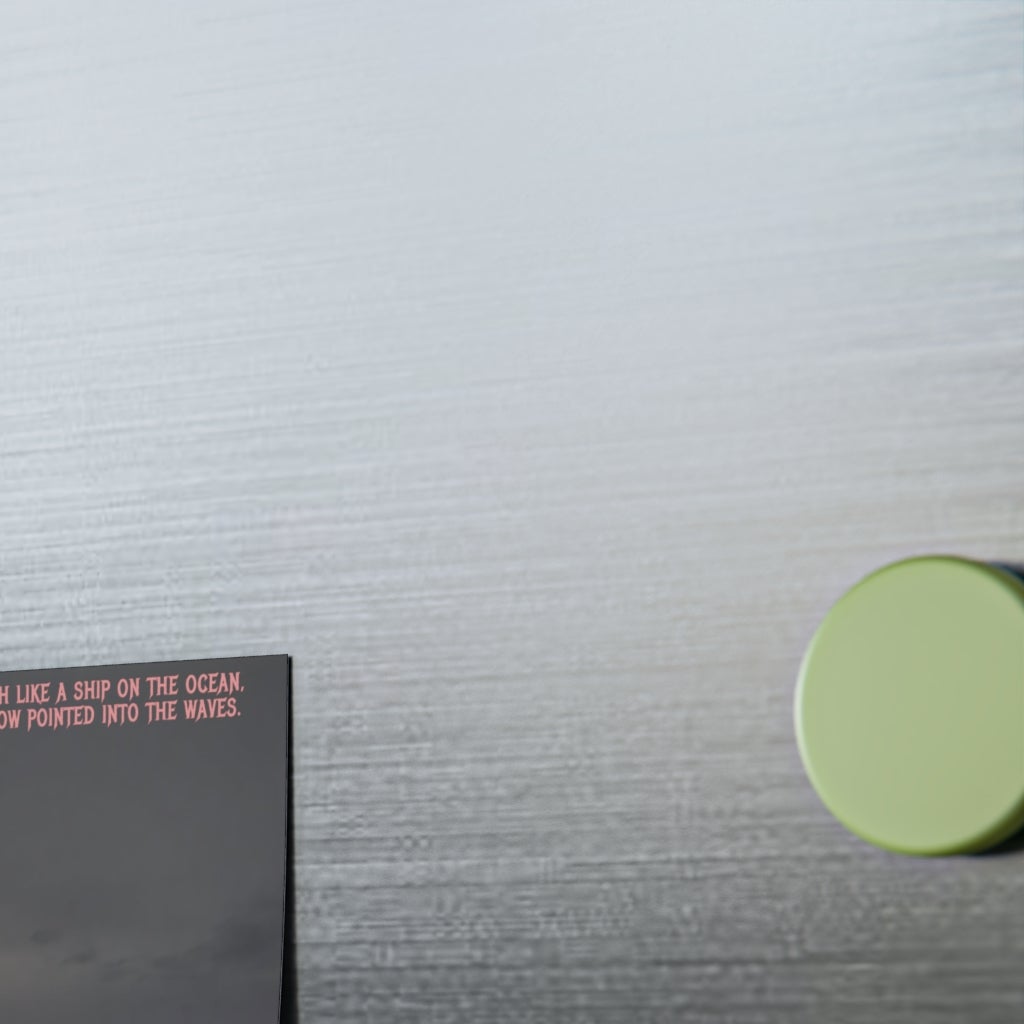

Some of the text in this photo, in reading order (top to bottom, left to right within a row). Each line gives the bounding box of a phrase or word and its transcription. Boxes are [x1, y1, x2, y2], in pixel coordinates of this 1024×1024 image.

[15, 681, 51, 705] LIKE
[56, 681, 68, 704] A
[73, 679, 112, 702] SHIP
[116, 677, 141, 700] ON
[145, 673, 179, 698] THE
[185, 671, 244, 695] OCEAN,
[26, 704, 95, 731] POINTED
[101, 701, 140, 728] INTO
[144, 699, 178, 722] THE
[182, 696, 241, 721] WAVES.
